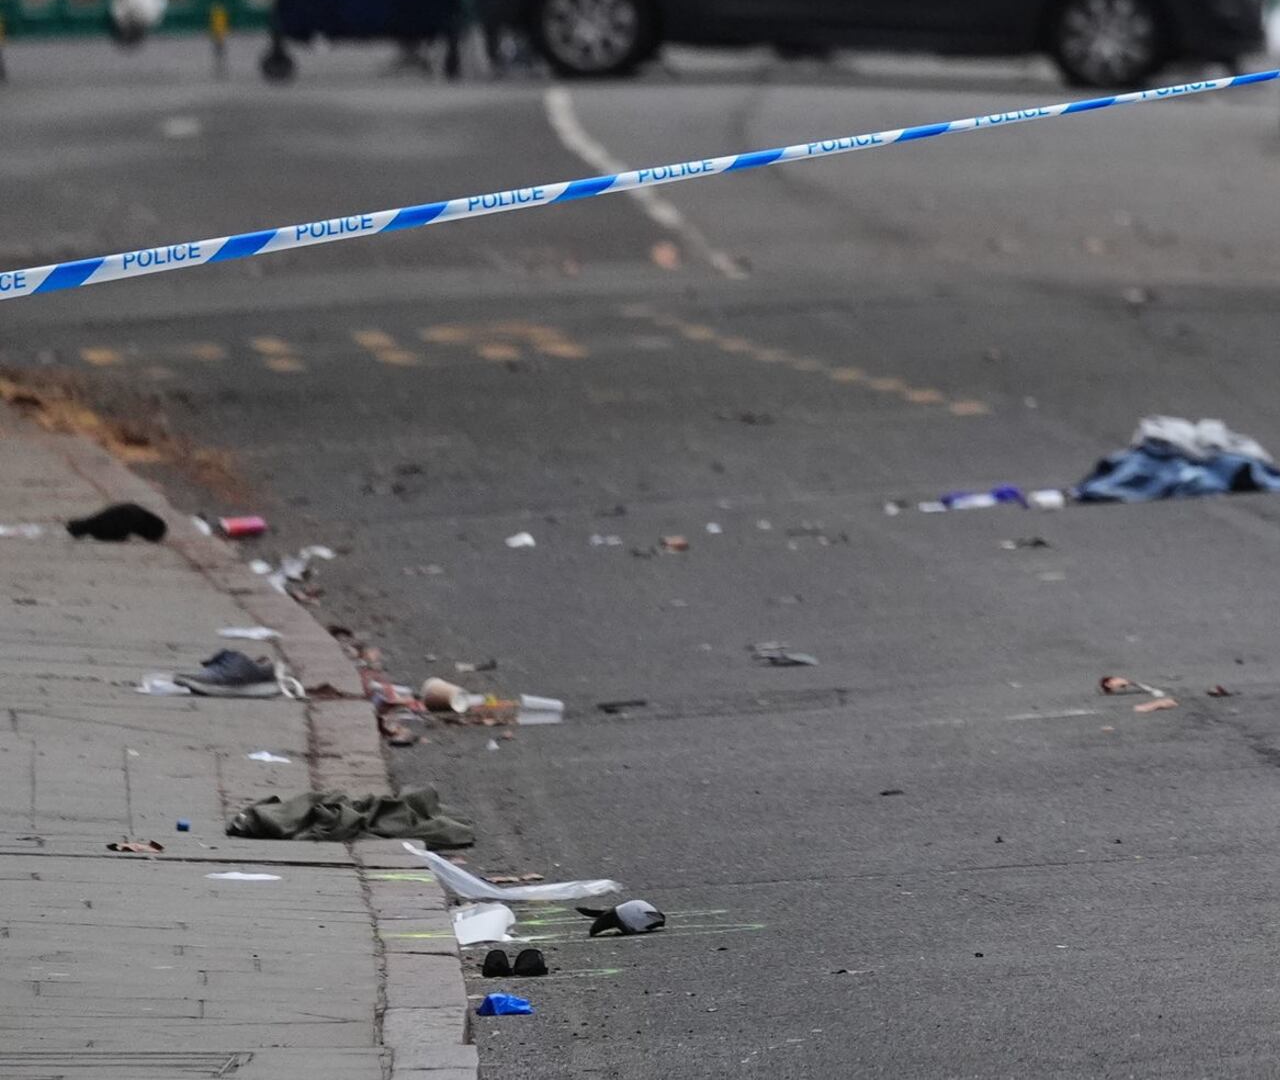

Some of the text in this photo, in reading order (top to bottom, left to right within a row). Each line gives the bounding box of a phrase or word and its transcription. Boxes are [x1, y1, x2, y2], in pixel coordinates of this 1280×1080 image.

[468, 187, 545, 212] POLICE
[296, 214, 374, 241] POLICE
[122, 241, 201, 270] POLICE
